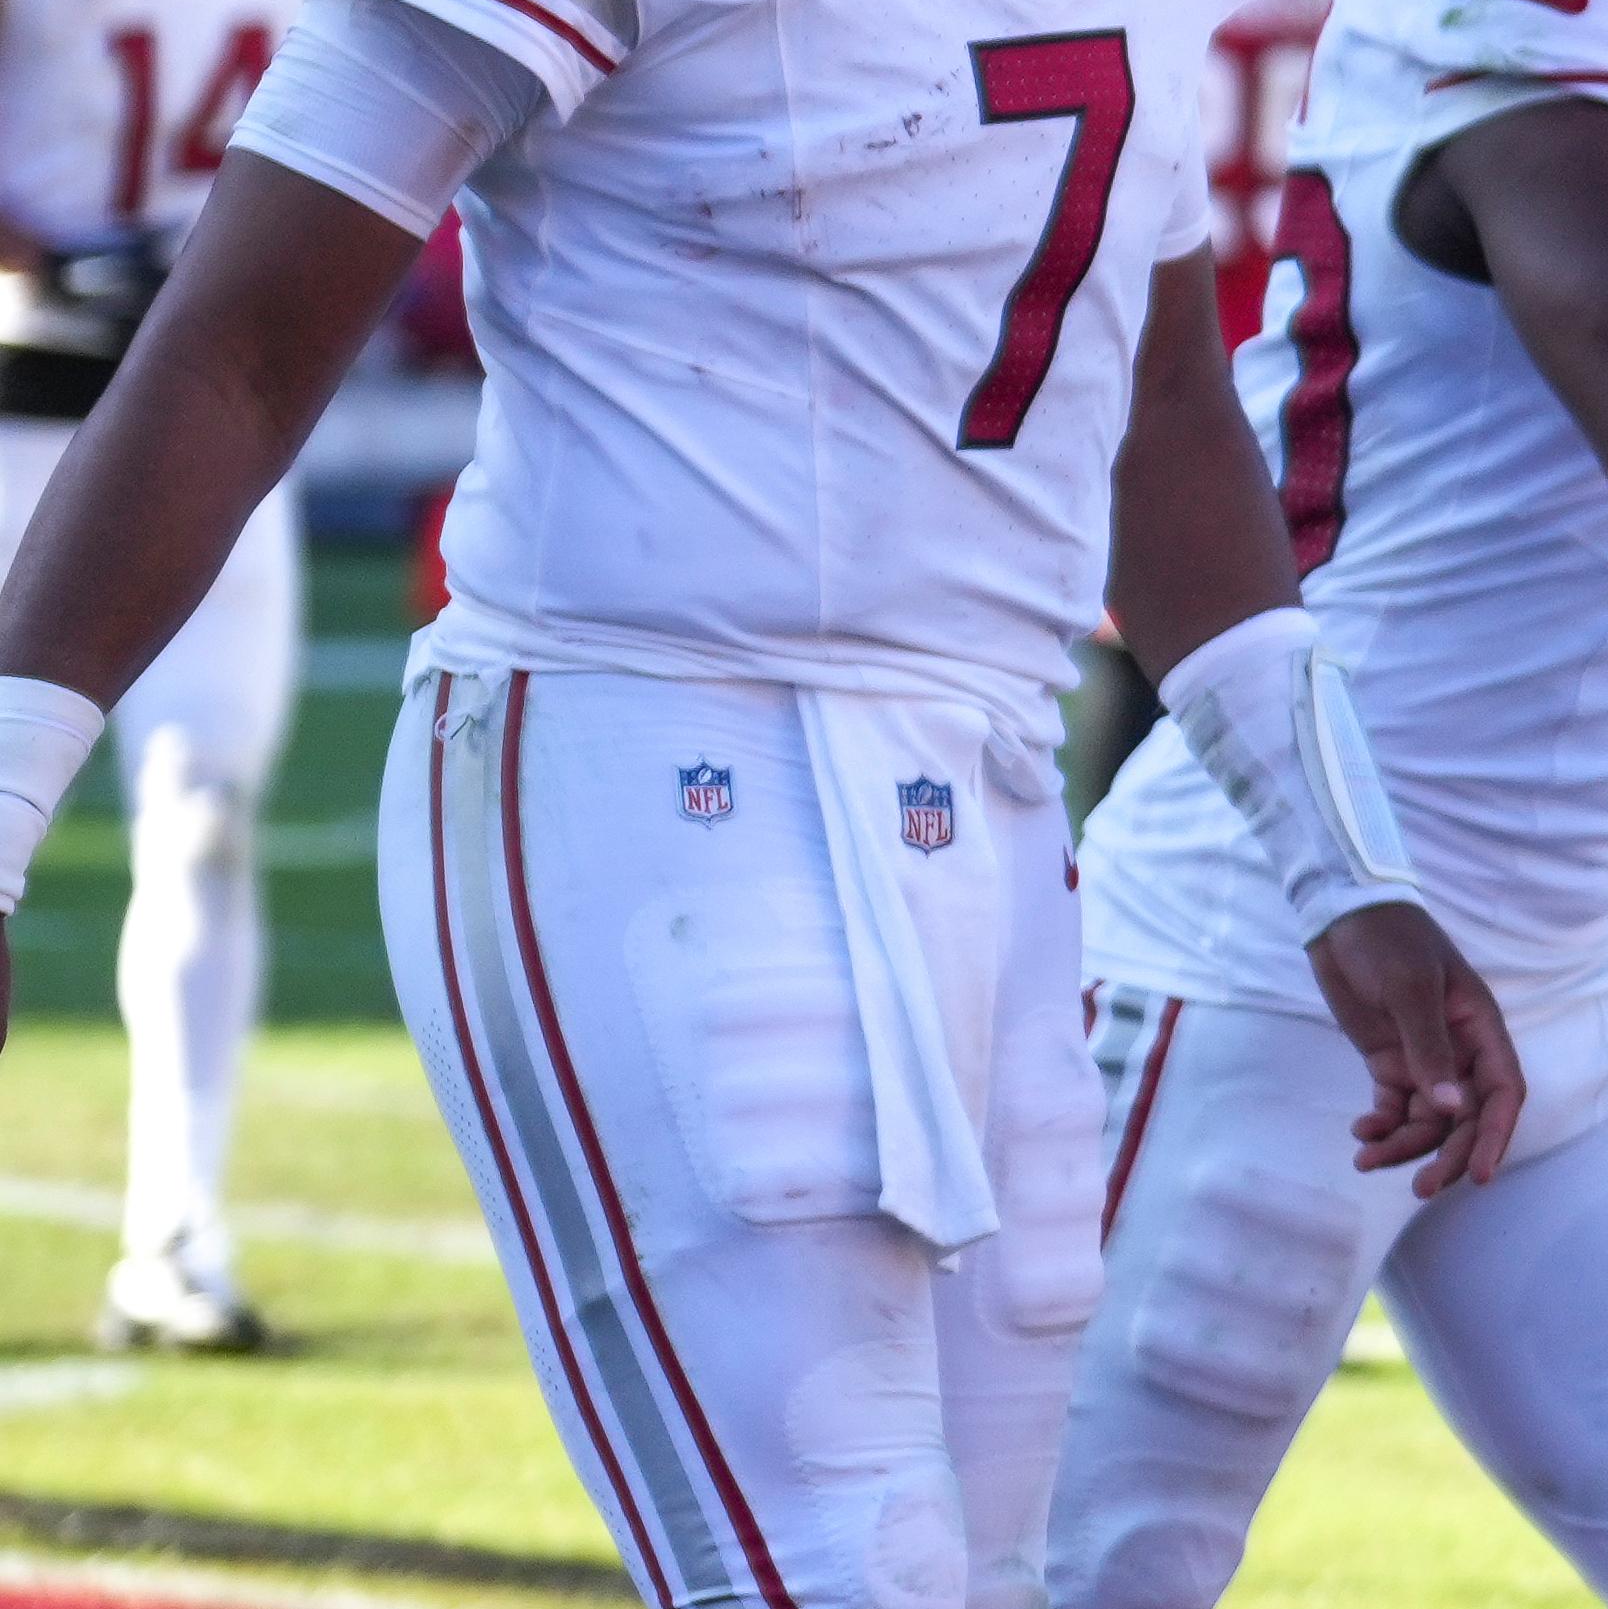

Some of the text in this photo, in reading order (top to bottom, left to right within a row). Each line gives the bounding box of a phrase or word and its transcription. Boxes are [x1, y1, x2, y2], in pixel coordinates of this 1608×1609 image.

[104, 19, 275, 218] 14
[957, 29, 1136, 450] 7
[685, 786, 729, 814] NFL
[905, 808, 949, 846] NFL
